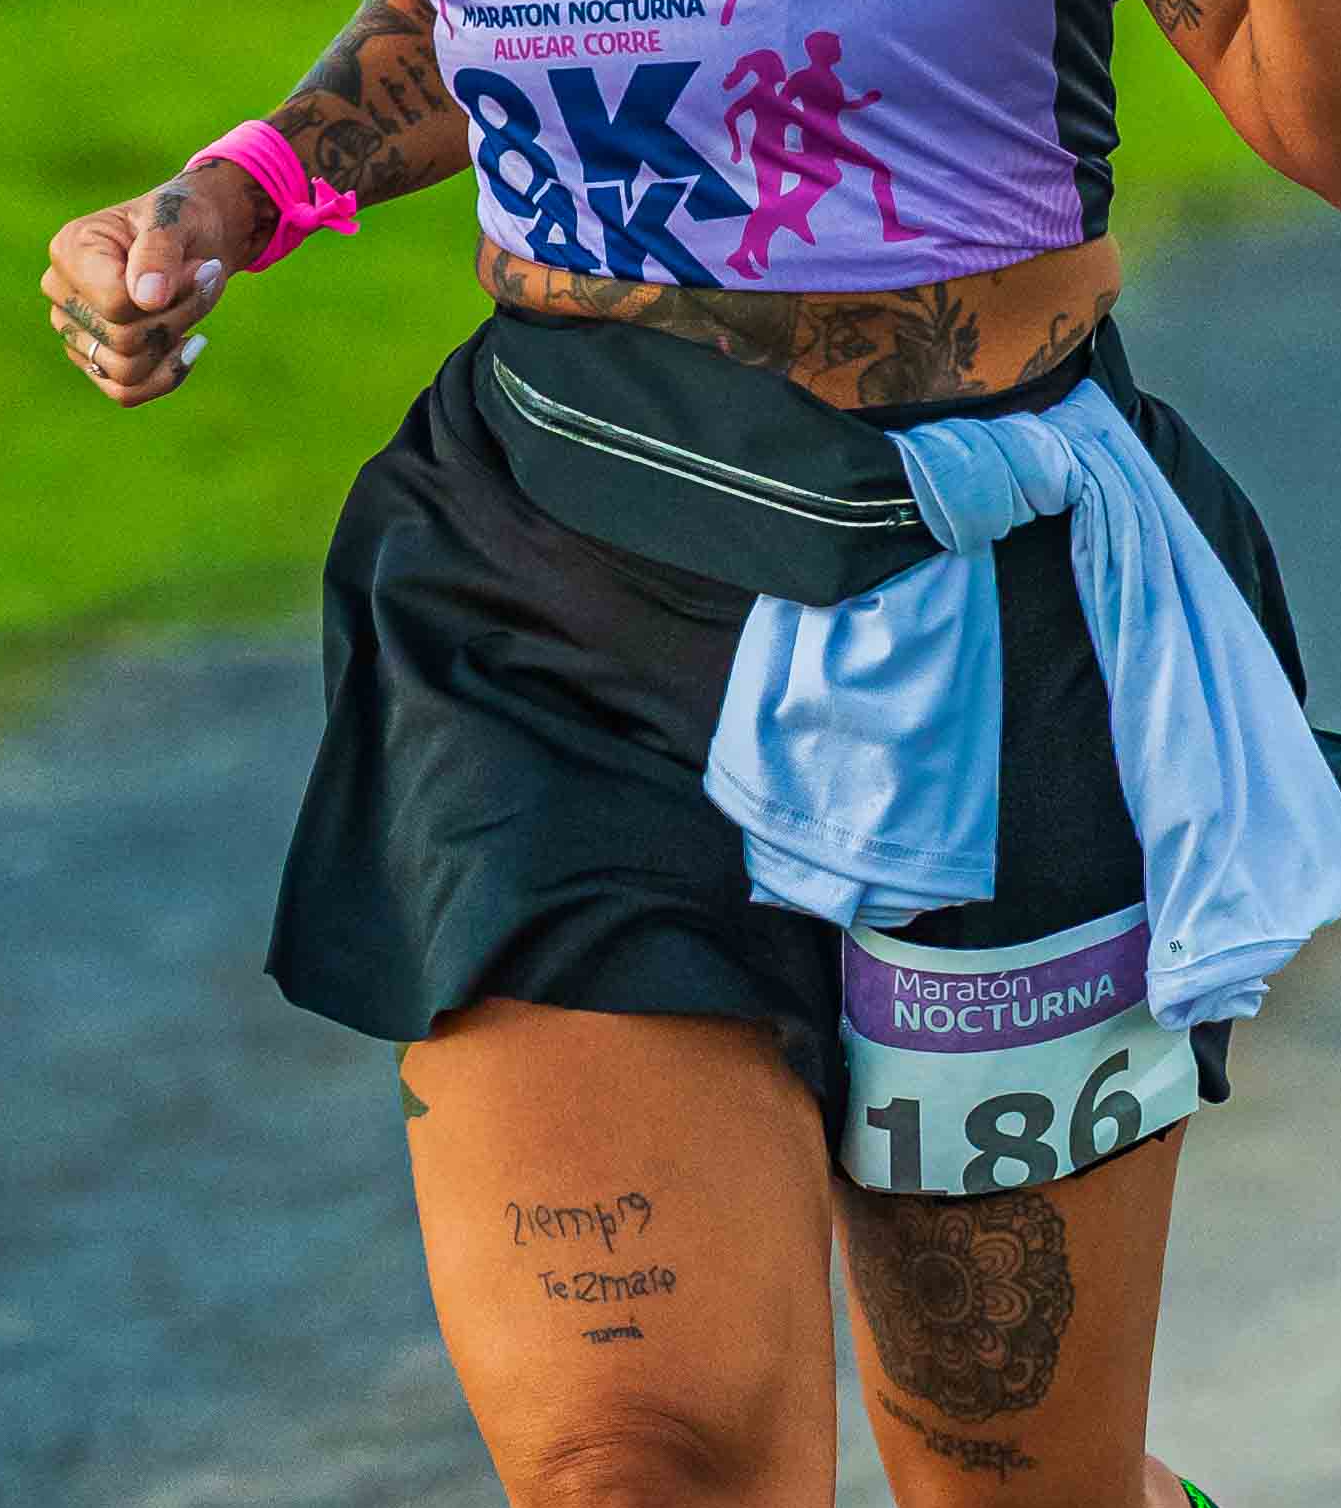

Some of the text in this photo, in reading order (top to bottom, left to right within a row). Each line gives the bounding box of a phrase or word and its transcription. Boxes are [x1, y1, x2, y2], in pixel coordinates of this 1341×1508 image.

[462, 2, 560, 29] MARATON
[493, 29, 663, 62] ALVEAR CORRE
[453, 60, 754, 223] 8K
[525, 180, 725, 290] 4K
[893, 969, 1031, 1002] Maratón
[893, 974, 1116, 1033] NOCTURNA
[866, 1047, 1143, 1195] 186
